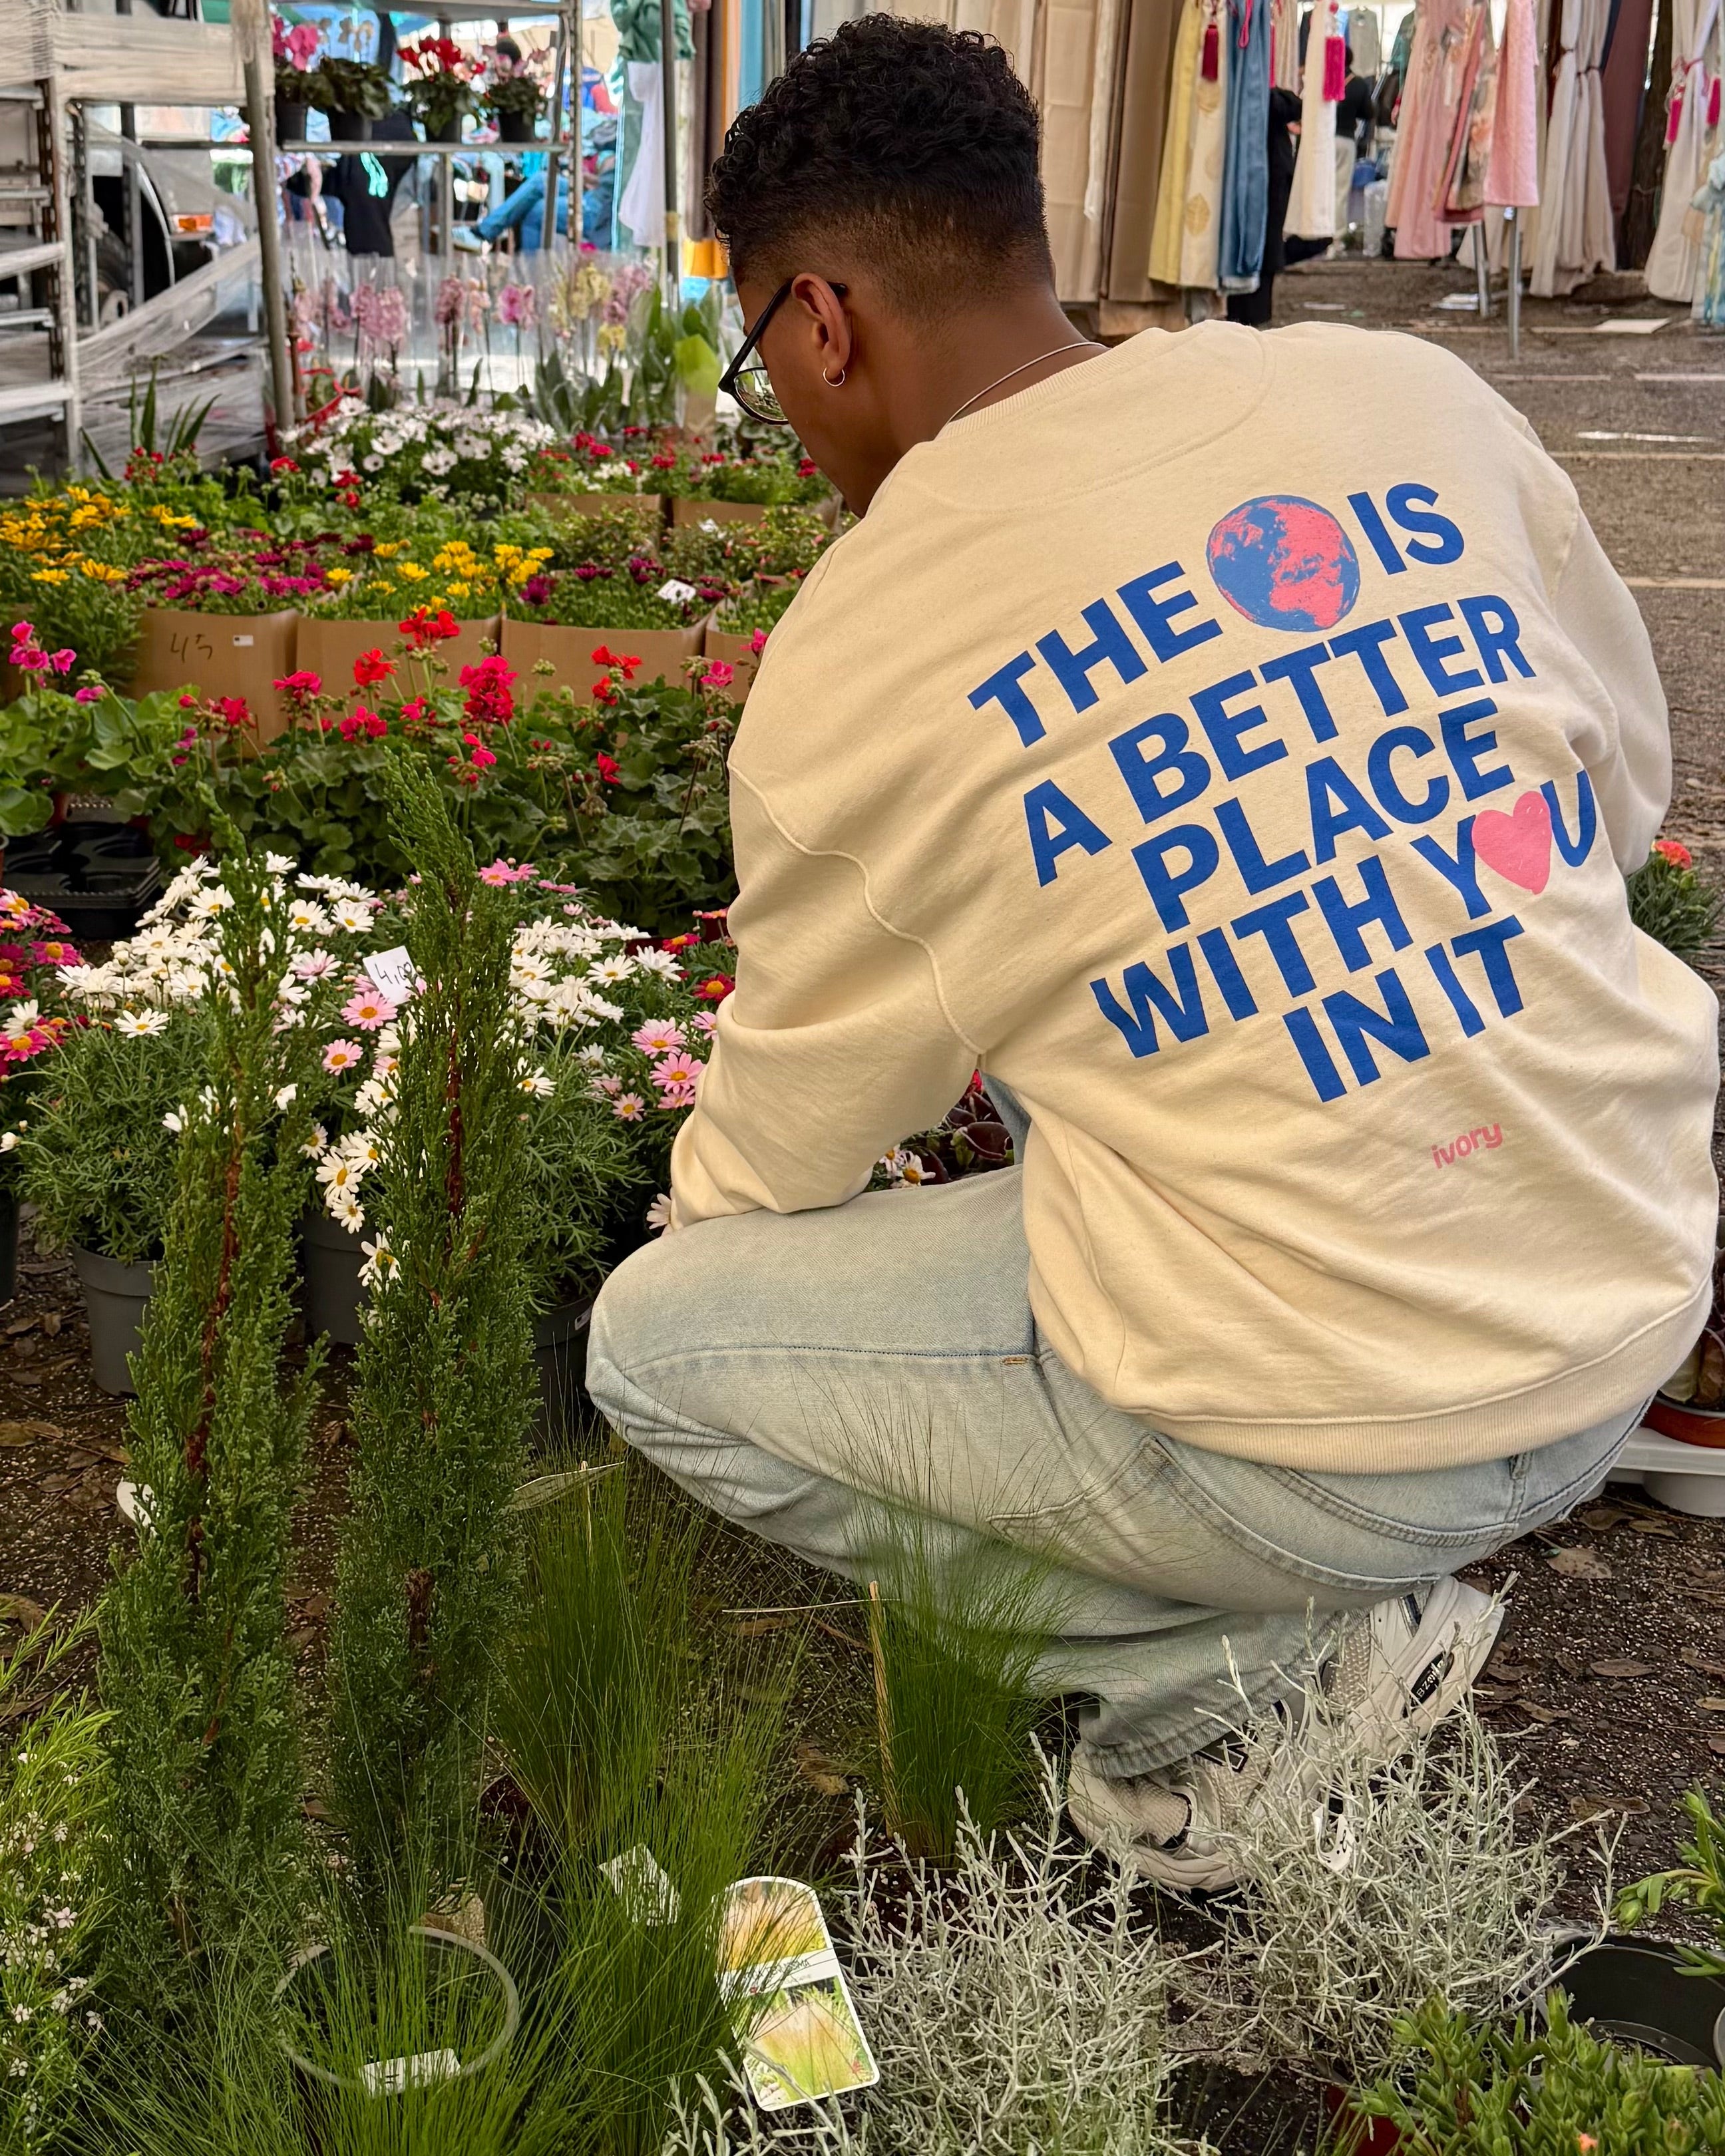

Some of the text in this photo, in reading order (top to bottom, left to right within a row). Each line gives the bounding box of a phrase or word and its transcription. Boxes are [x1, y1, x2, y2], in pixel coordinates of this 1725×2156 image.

[968, 483, 1465, 747] THE IS
[1024, 595, 1535, 886] A BETTER
[1131, 698, 1514, 933] PLACE
[1090, 856, 1412, 1058] WITH
[1283, 916, 1524, 1103] IN IT
[1431, 1122, 1503, 1168] ivory
